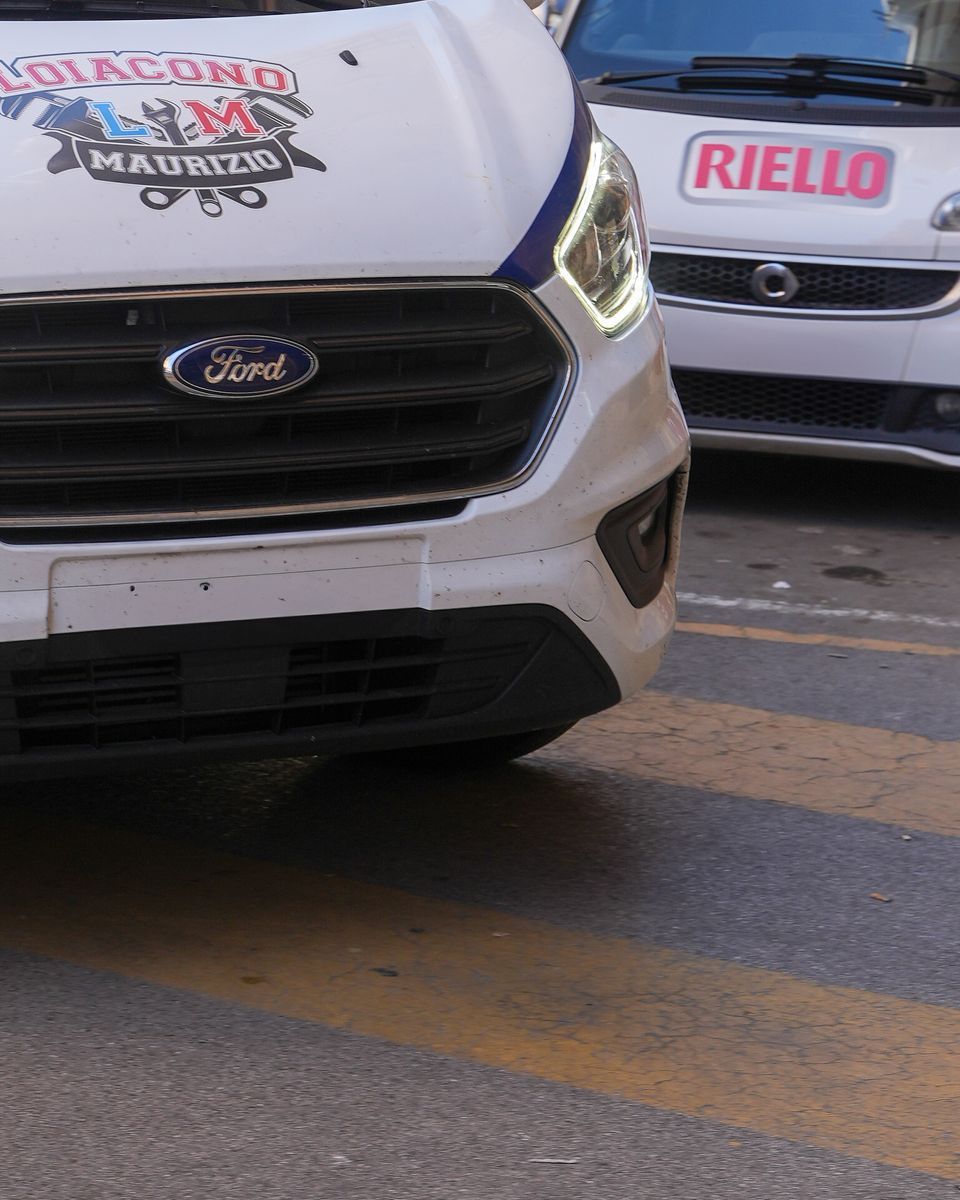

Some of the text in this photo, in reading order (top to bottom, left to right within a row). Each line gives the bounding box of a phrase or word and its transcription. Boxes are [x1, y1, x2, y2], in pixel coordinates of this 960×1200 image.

[89, 99, 266, 139] L M
[87, 147, 283, 177] MAURIZIO
[693, 142, 889, 201] RIELLO
[203, 345, 288, 385] Ford
